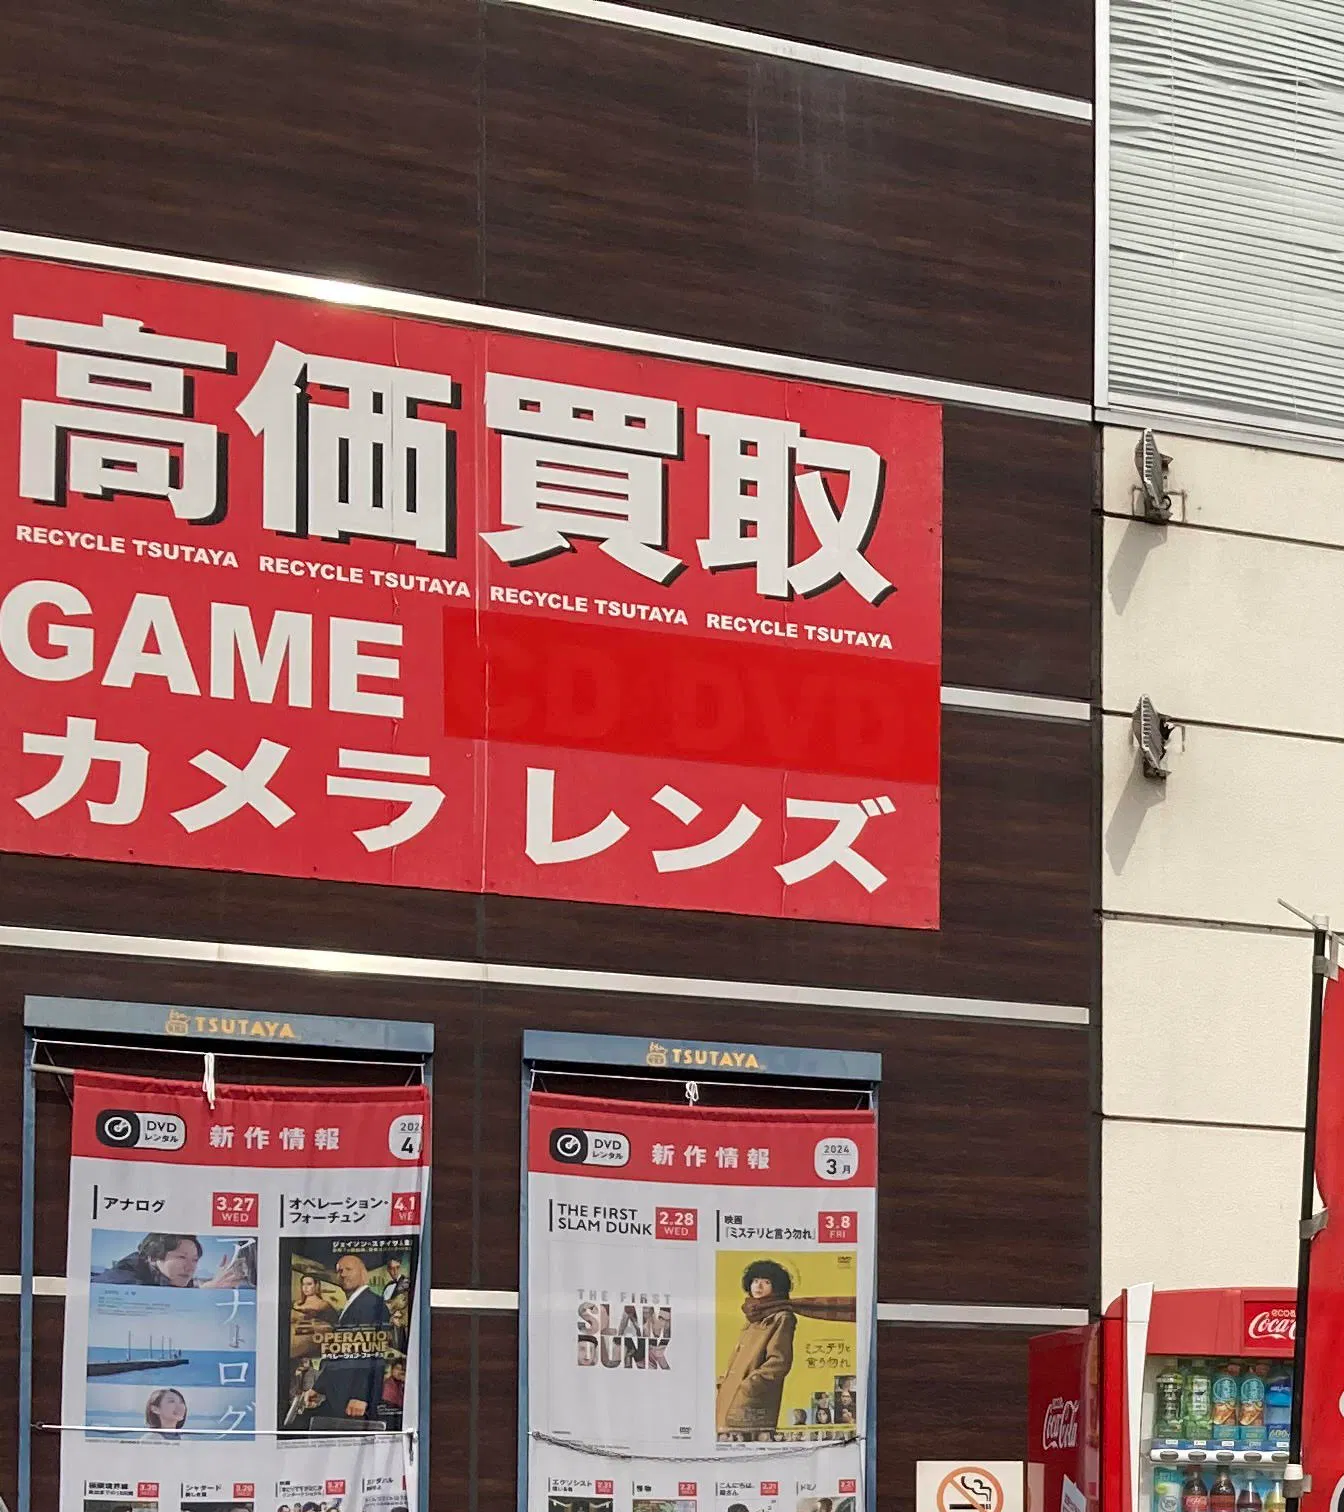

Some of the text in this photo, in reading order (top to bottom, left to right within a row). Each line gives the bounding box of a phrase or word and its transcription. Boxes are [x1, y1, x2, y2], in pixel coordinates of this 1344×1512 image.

[13, 314, 895, 605] 高価買取
[16, 525, 892, 650] RECYCLE TSUTAYA RECYCLE TSUTAYA RECYCLE TSUTAYA RECYCLE TSUTAYA
[2, 581, 403, 718] GAME
[16, 716, 895, 894] カメラ レンズ
[196, 1016, 296, 1038] TSUTAYA
[672, 1048, 760, 1069] TSUTAYA
[147, 1121, 177, 1132] DVD
[144, 1134, 179, 1143] レンタル
[209, 1125, 339, 1151] 新作情報
[594, 1139, 622, 1149] DVD
[592, 1151, 624, 1159] レンタル
[652, 1143, 770, 1169] 新作情報
[824, 1145, 849, 1154] 2024
[104, 1197, 165, 1212] アナログ
[216, 1197, 254, 1211] 3.27
[557, 1203, 638, 1220] THE FIRST
[221, 1213, 249, 1222] WED
[290, 1212, 366, 1224] フォーチュン
[659, 1211, 694, 1225] 2.28
[825, 1215, 851, 1229] 3.8
[558, 1217, 652, 1235] SLAM DUNK
[664, 1227, 688, 1235] WED
[577, 1289, 671, 1304] THE FIRST
[577, 1302, 671, 1338] SLAM
[321, 1341, 389, 1352] FORTUNE
[578, 1335, 671, 1369] DUNK
